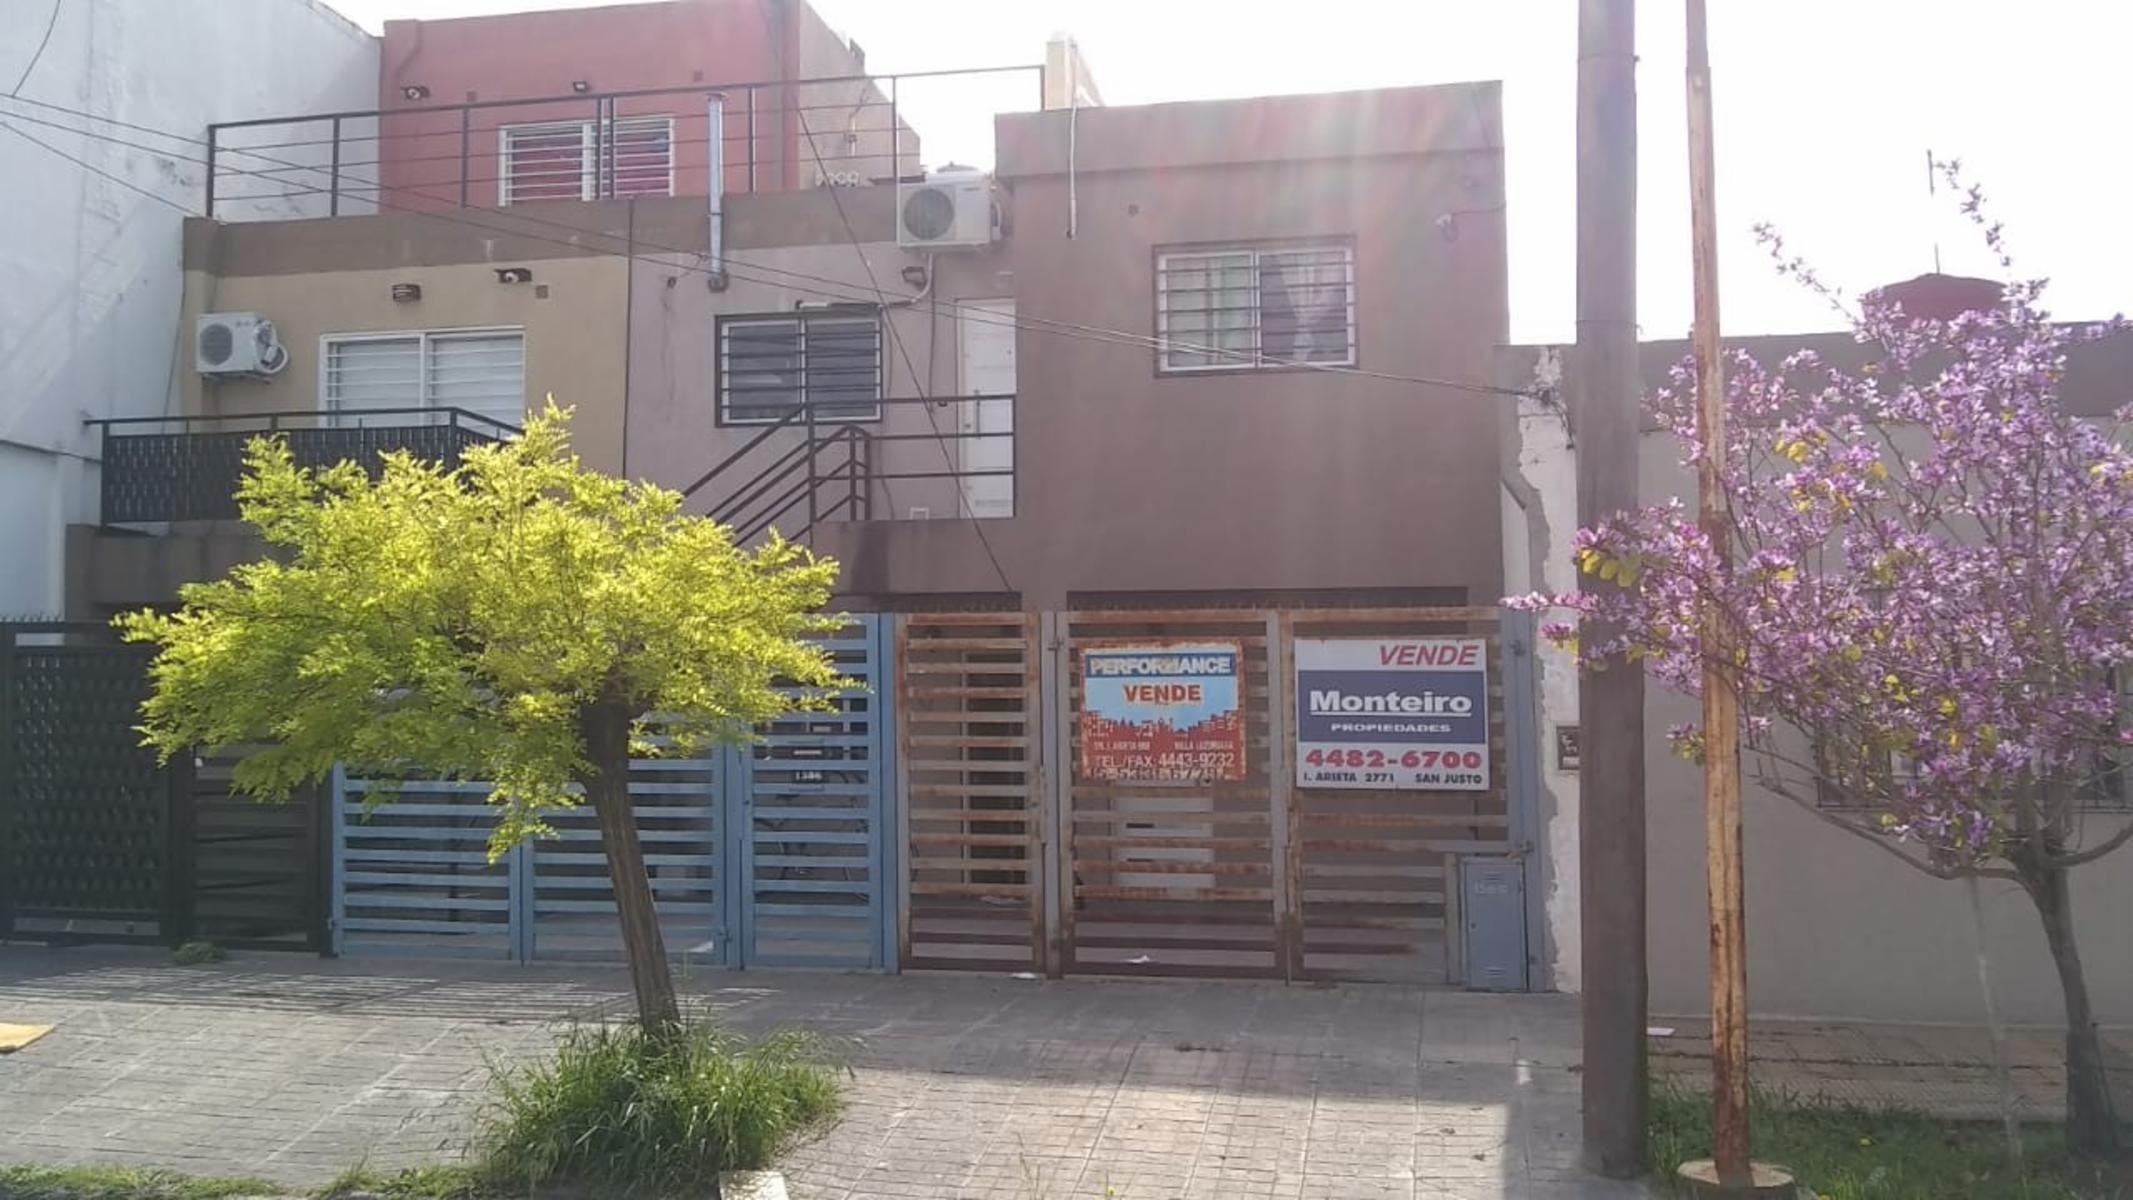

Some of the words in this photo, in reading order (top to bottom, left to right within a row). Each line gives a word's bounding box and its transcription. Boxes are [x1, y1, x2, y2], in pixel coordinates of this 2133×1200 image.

[1379, 644, 1479, 666] VENDE
[1090, 656, 1231, 675] PERFORMANCE
[1123, 684, 1201, 703] VENDE
[1309, 689, 1472, 713] Monteiro
[1330, 722, 1452, 733] PROPIEDADES
[1158, 752, 1235, 768] 4443-9232
[1306, 748, 1482, 770] 4482-6700
[1315, 772, 1357, 783] ARIETA
[1364, 773, 1395, 783] 2771
[1415, 773, 1441, 784] SAN
[1443, 774, 1483, 785] JUSTO
